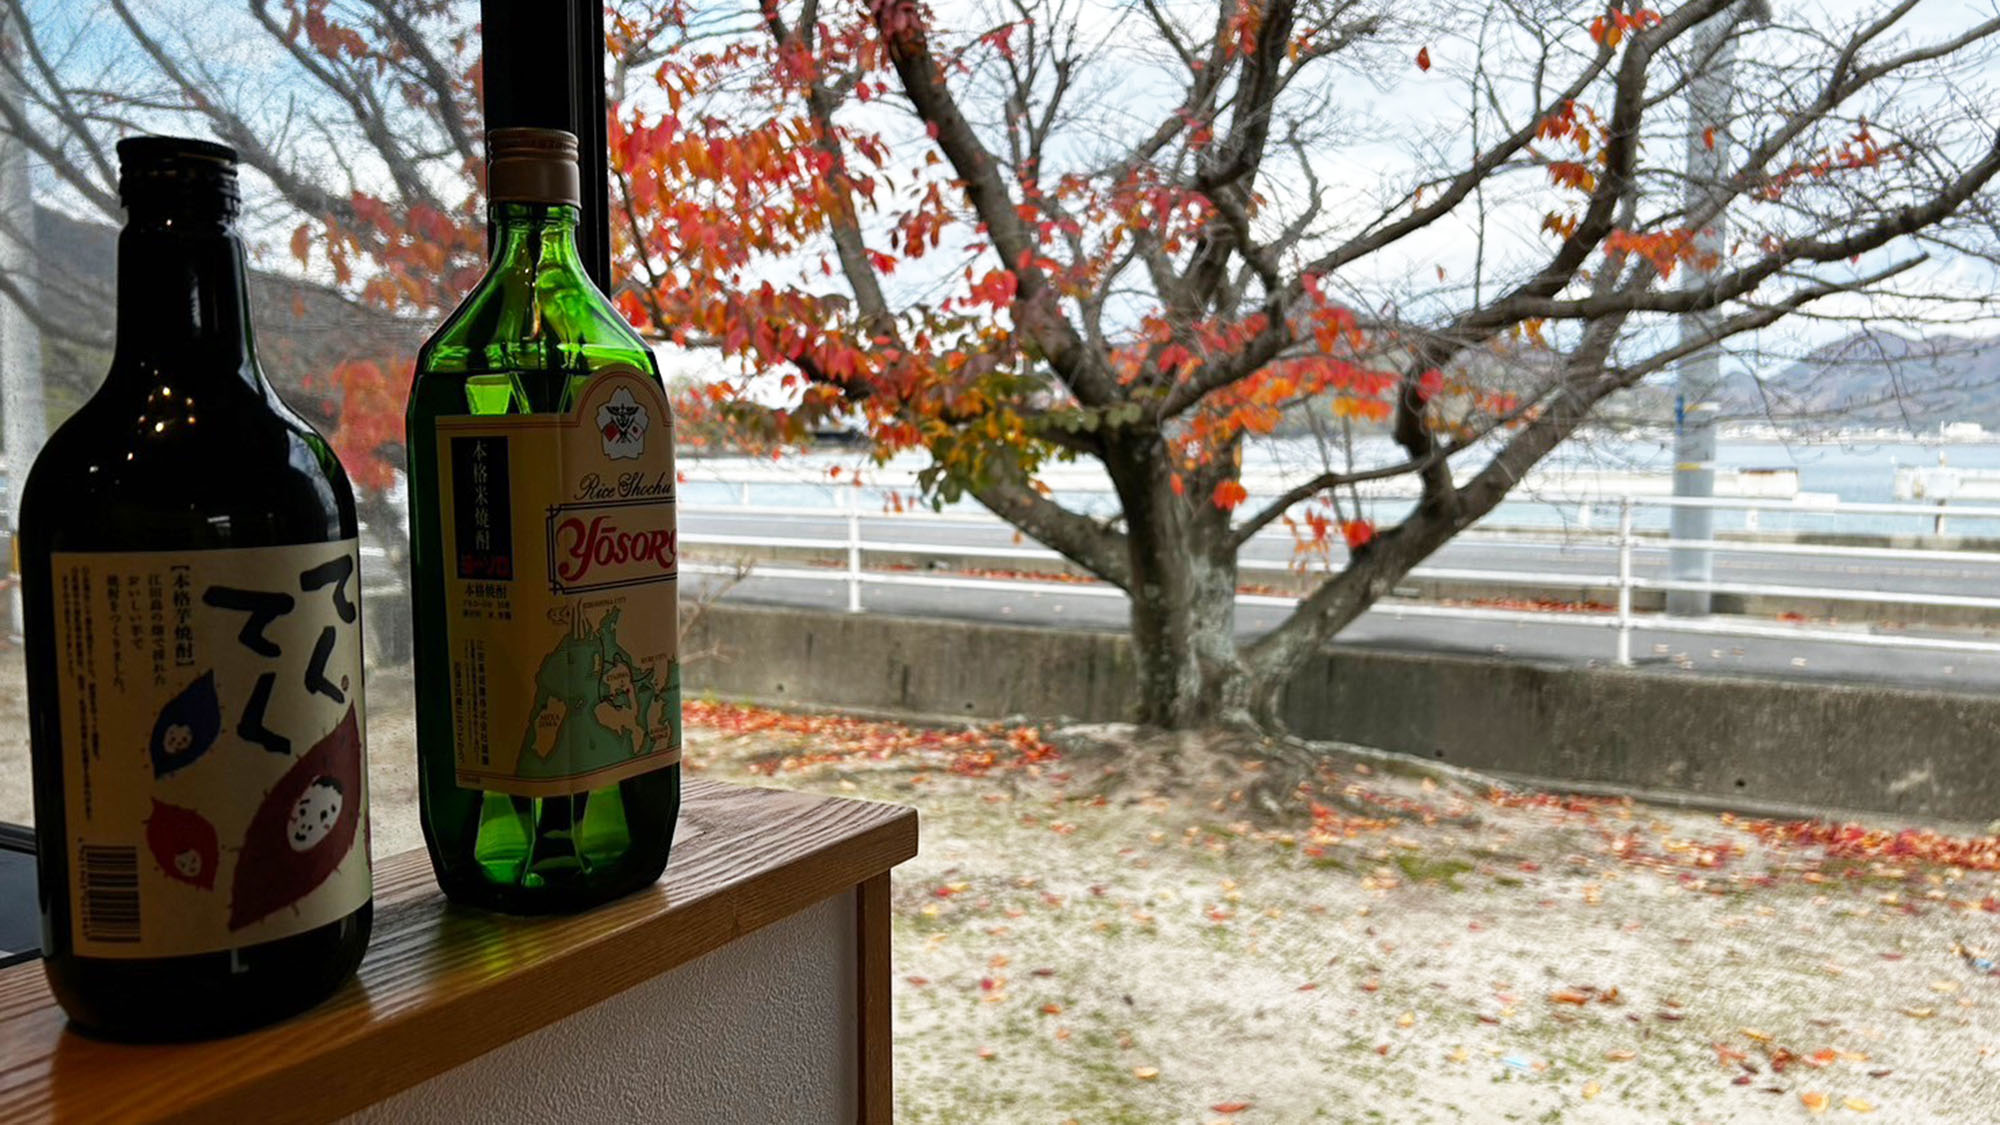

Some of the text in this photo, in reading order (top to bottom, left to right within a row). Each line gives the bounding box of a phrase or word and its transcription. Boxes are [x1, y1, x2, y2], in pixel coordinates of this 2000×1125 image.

[473, 440, 490, 551] 本格米焼酎
[574, 471, 672, 500] Rice Shochu
